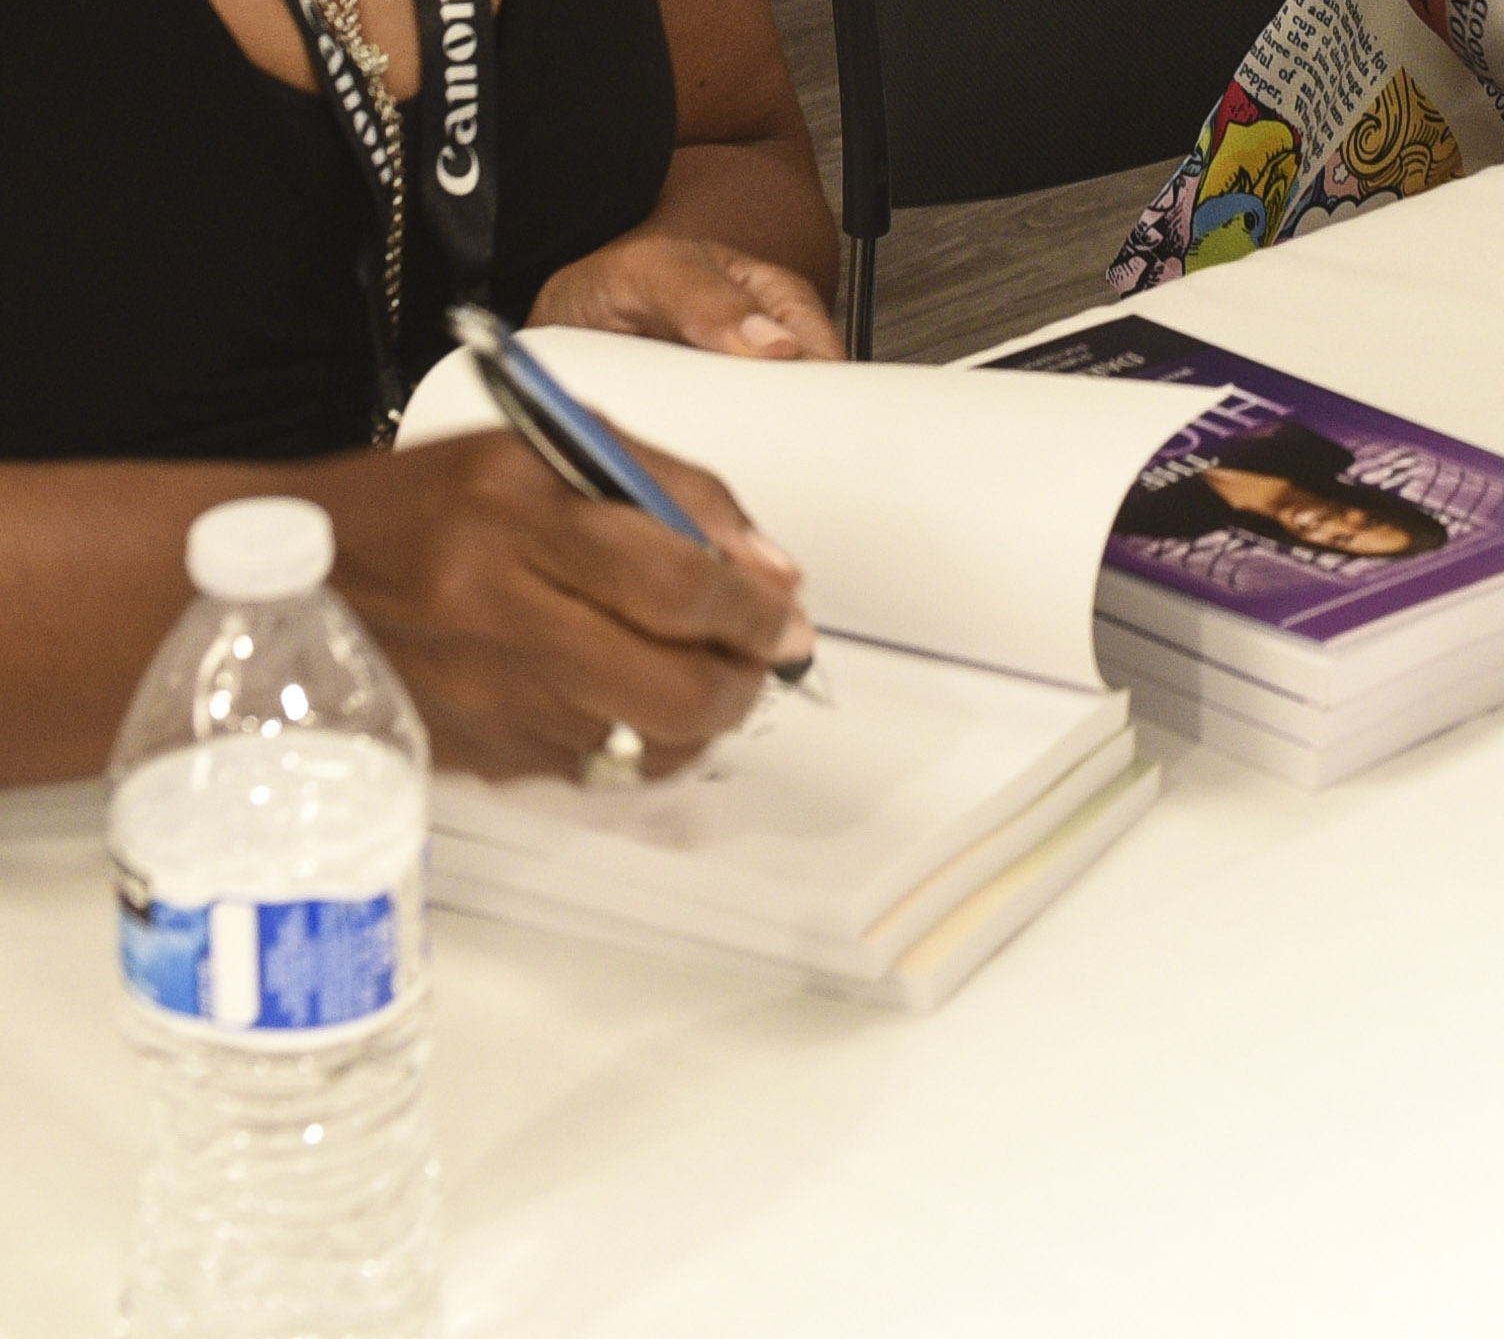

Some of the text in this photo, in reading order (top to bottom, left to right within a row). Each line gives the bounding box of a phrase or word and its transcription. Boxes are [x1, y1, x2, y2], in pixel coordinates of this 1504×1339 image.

[1292, 14, 1317, 37] cup
[1307, 5, 1334, 28] add
[1262, 28, 1291, 59] three
[1286, 30, 1309, 52] the
[1278, 68, 1295, 85] of
